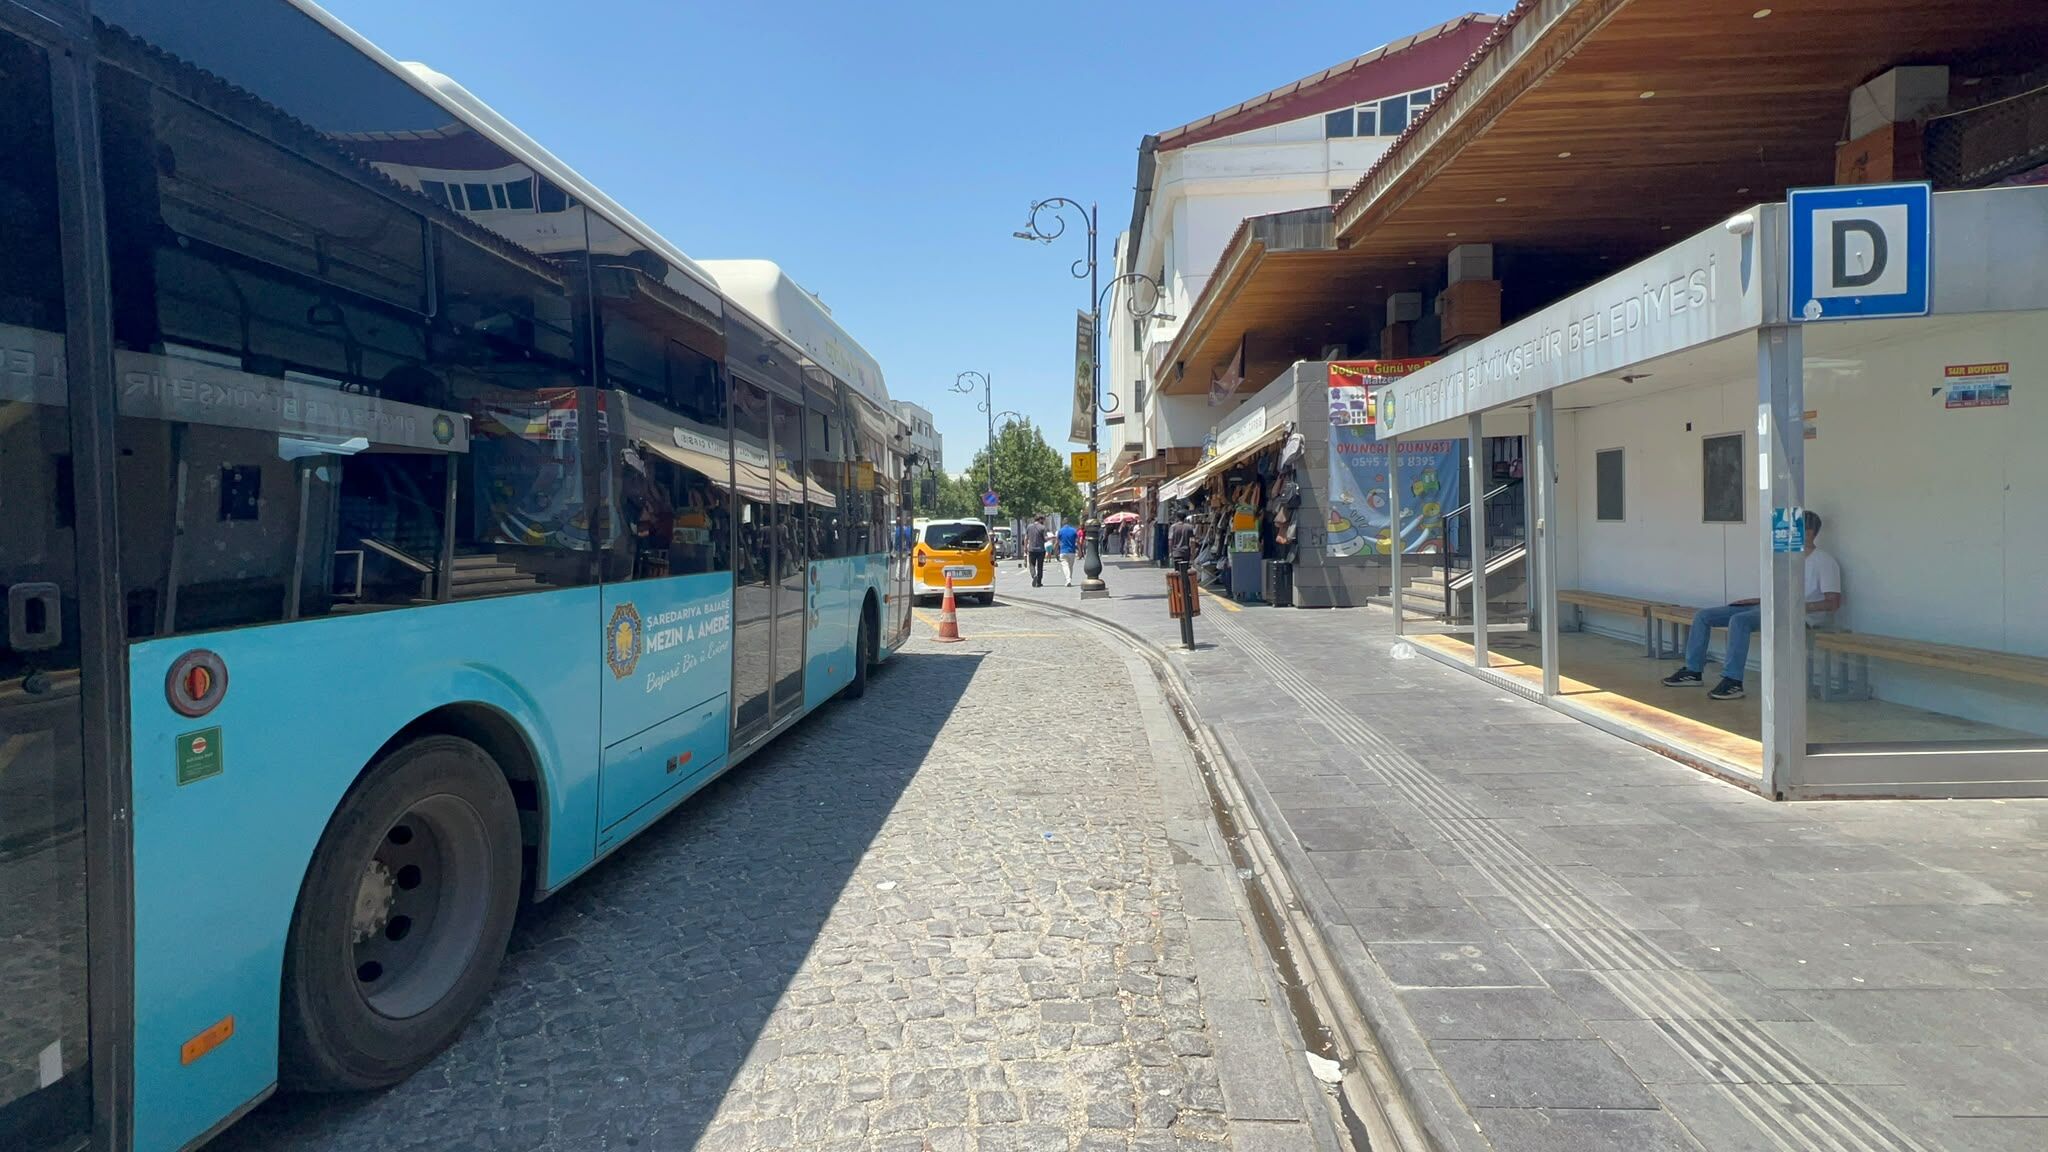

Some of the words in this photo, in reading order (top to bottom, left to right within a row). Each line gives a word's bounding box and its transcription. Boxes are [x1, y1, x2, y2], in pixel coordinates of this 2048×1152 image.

[1832, 219, 1888, 288] D
[1404, 371, 1464, 412] DİYARBAKIR
[1467, 326, 1562, 392] BÜYÜKŞEHİR
[1568, 254, 1717, 353] BELEDİYESİ
[1374, 362, 1404, 375] Günü
[646, 626, 683, 655] MEZIN
[686, 624, 695, 642] A
